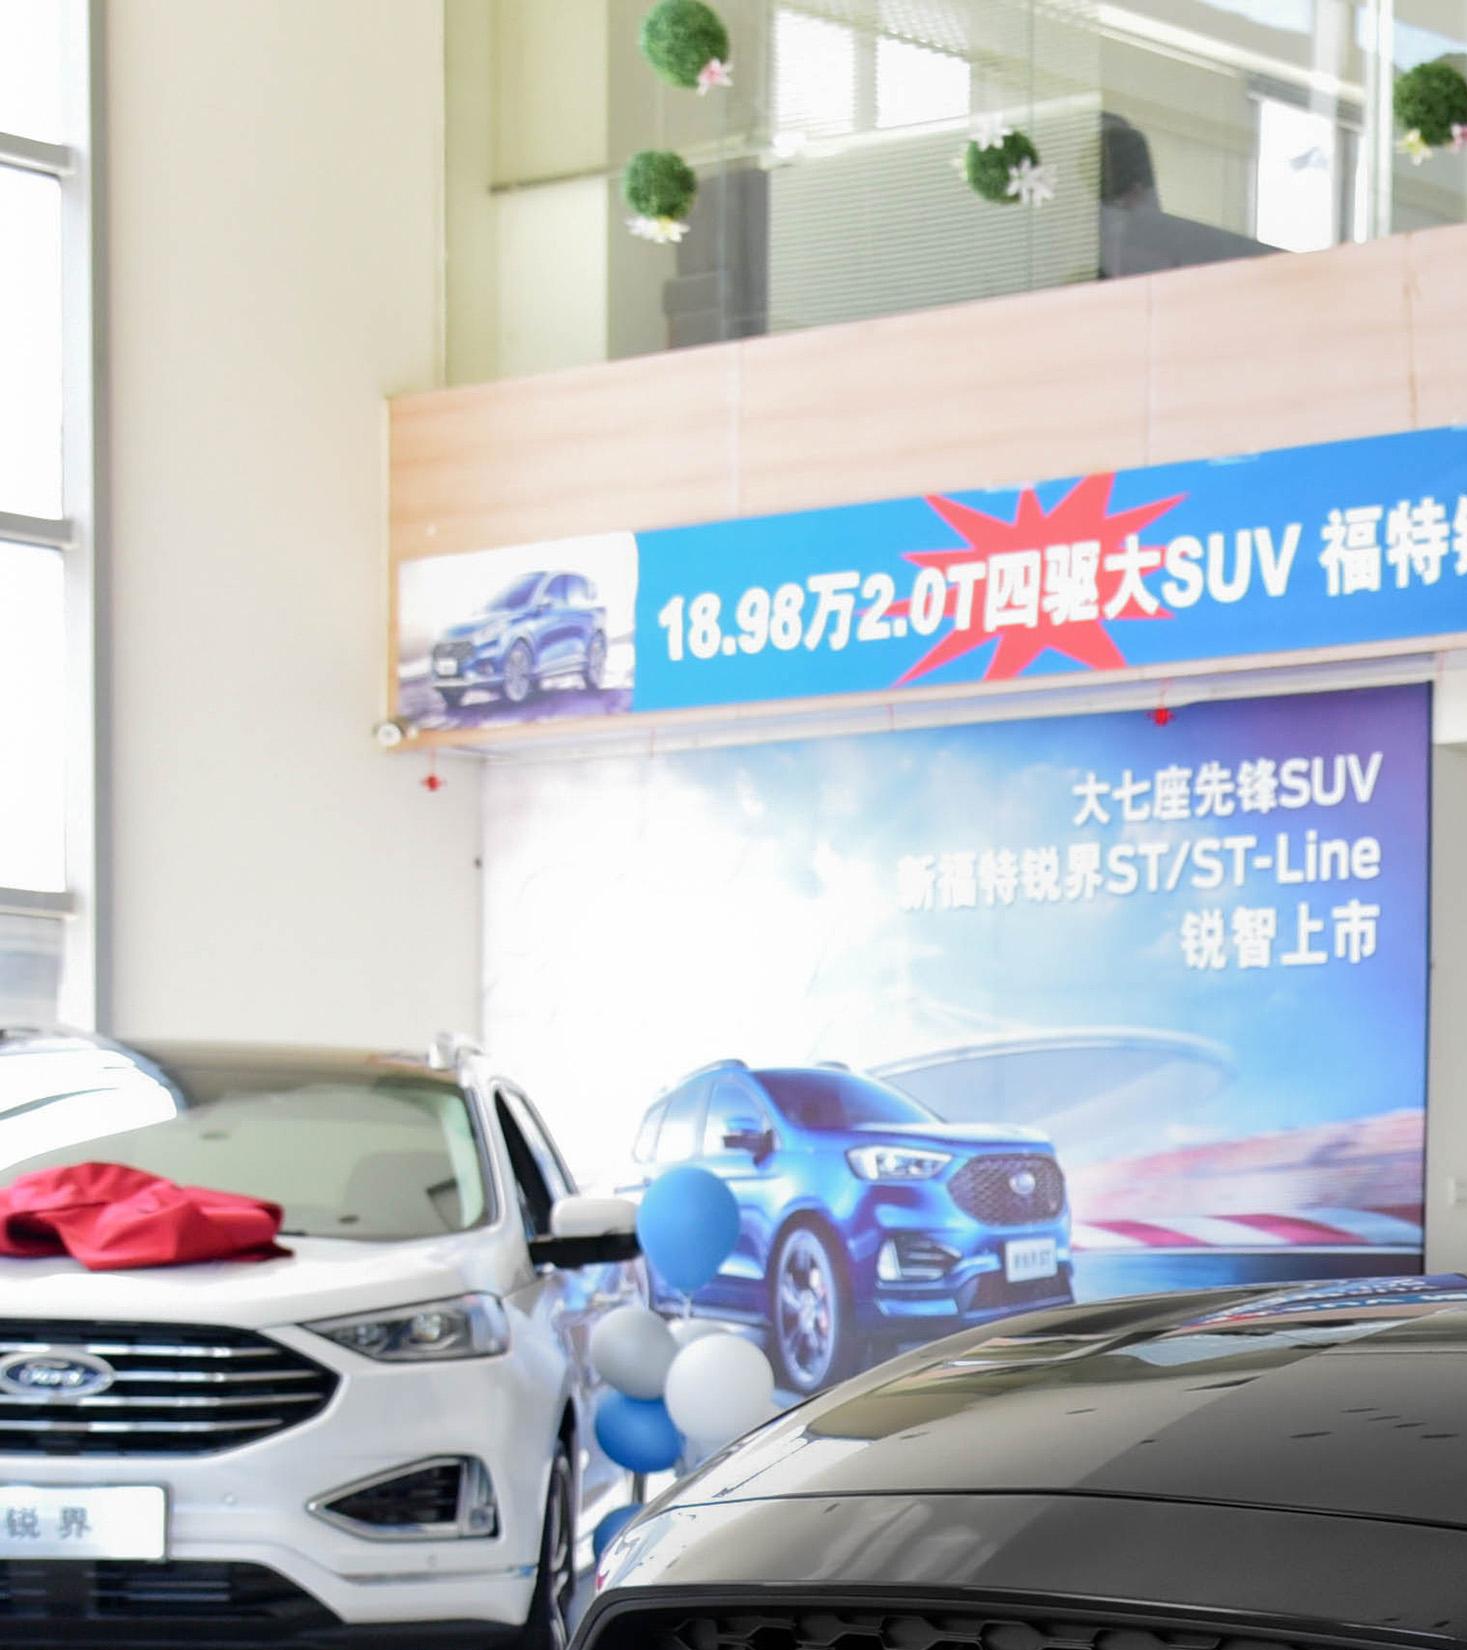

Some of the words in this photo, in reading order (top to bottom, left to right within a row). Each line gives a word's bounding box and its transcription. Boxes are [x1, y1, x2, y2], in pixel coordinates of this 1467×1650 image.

[1072, 751, 1384, 828] 大七座先锋SUV
[1180, 898, 1381, 971] 锐智上市
